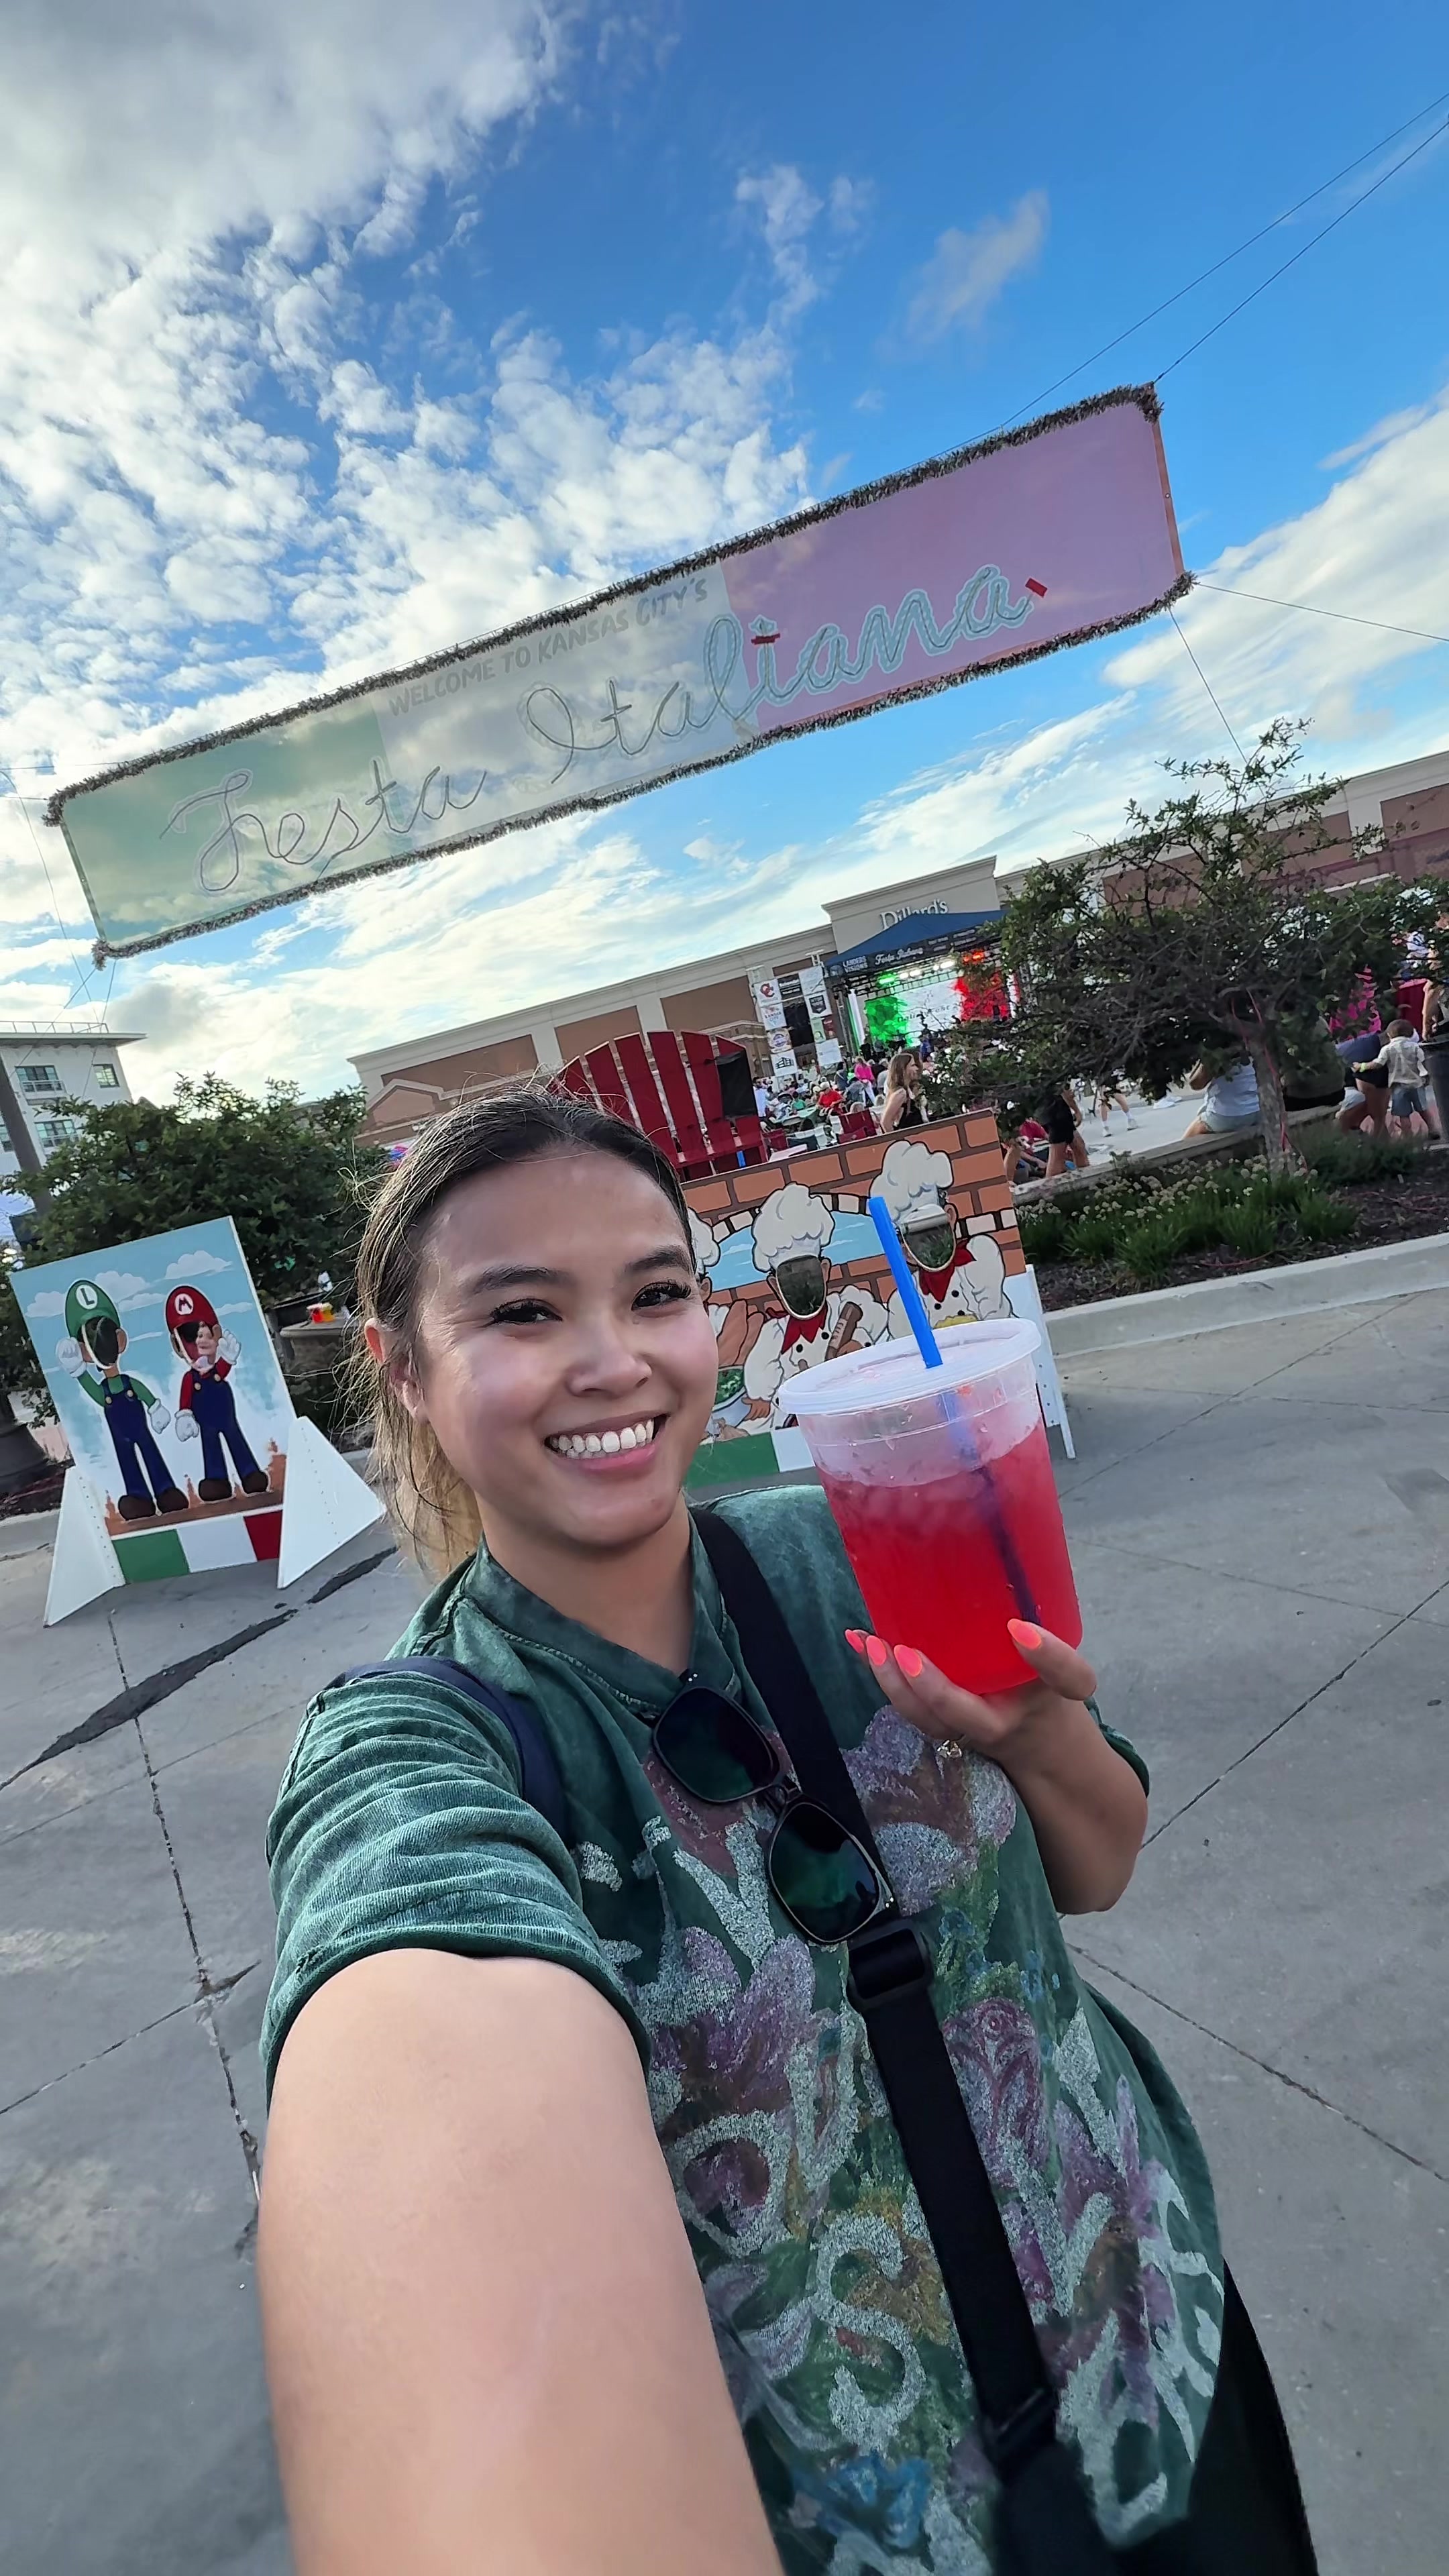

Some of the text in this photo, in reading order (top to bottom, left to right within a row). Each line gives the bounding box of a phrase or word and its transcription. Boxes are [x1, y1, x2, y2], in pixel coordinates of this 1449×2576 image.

[388, 577, 708, 716] WELCOME TO KANSAS CITY'S
[160, 564, 1038, 892] Festa Italiana
[80, 1287, 95, 1306] L
[178, 1295, 193, 1311] M
